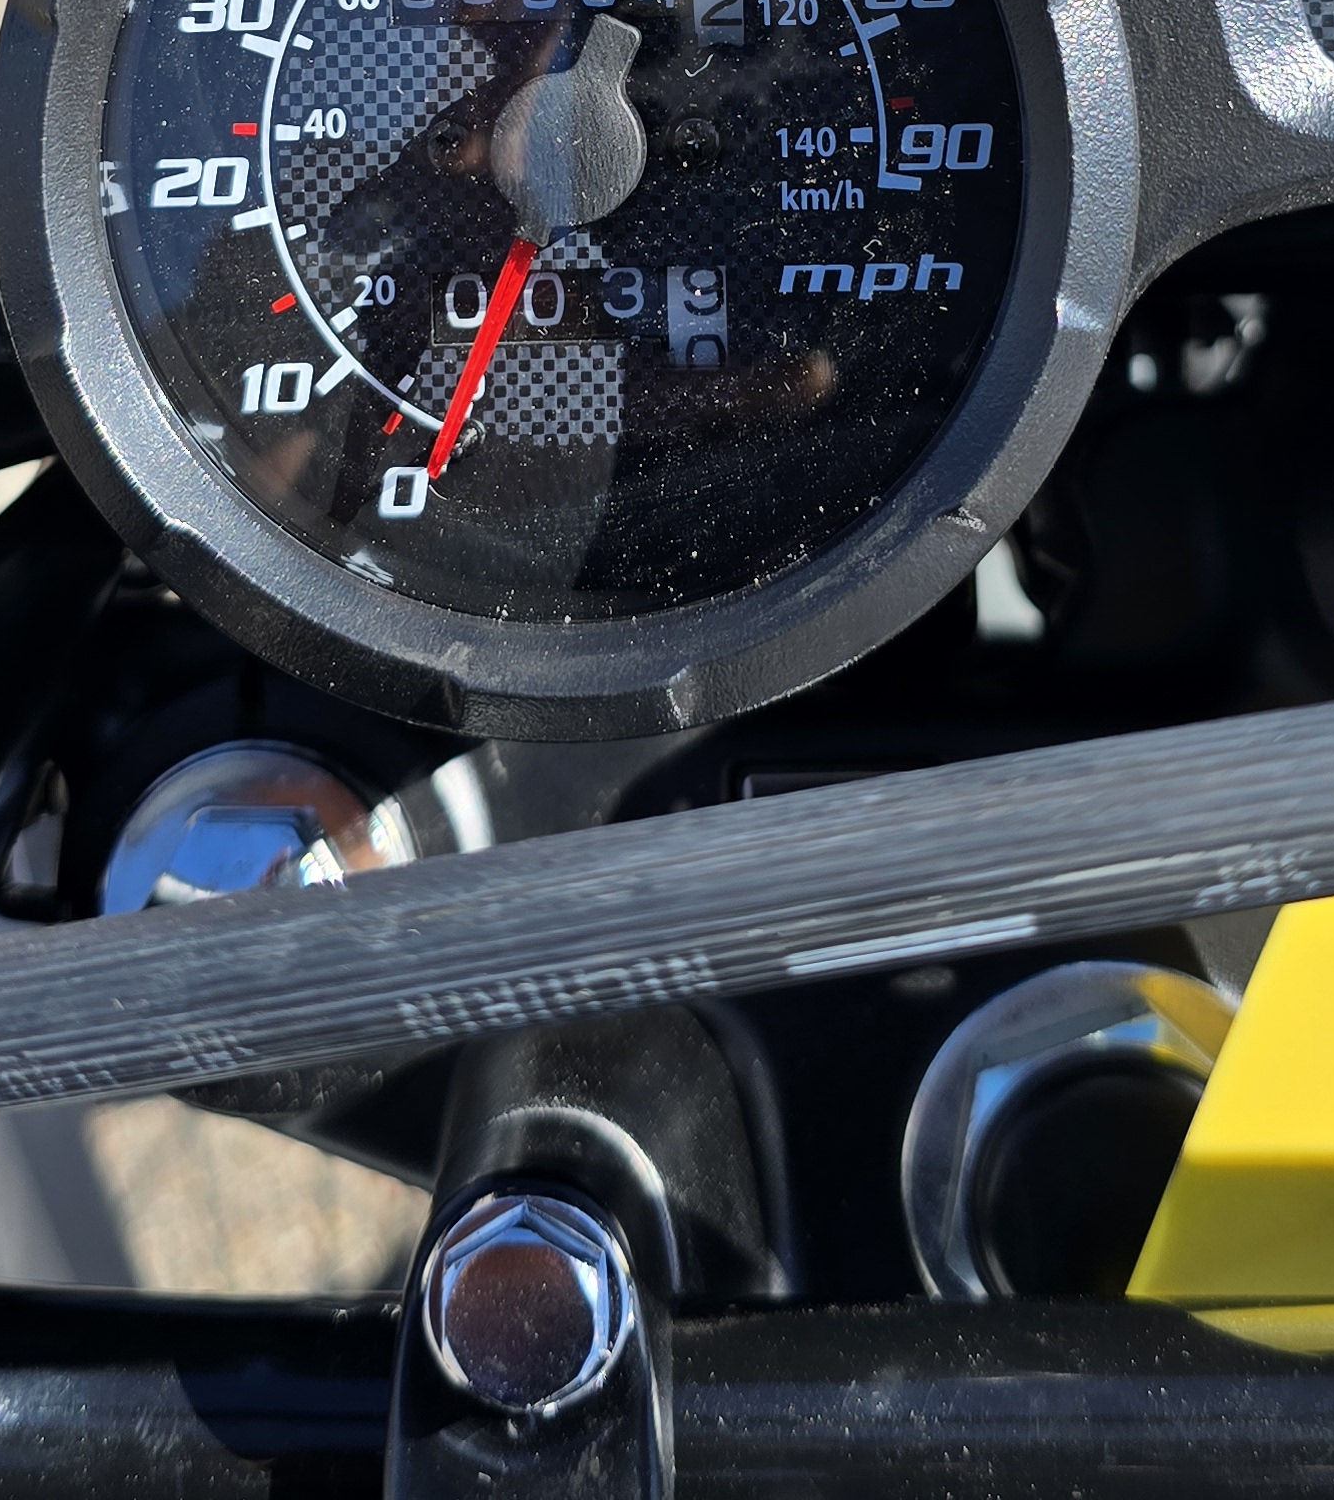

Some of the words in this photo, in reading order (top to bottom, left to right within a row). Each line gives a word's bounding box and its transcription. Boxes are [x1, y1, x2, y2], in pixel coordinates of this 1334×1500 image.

[303, 107, 348, 140] 40
[774, 126, 837, 158] 140
[897, 122, 995, 171] 90
[150, 156, 250, 208] 20
[780, 180, 865, 212] km/h
[352, 274, 396, 306] 20
[778, 254, 965, 300] mph
[240, 361, 314, 415] 10
[378, 465, 431, 519] 0
